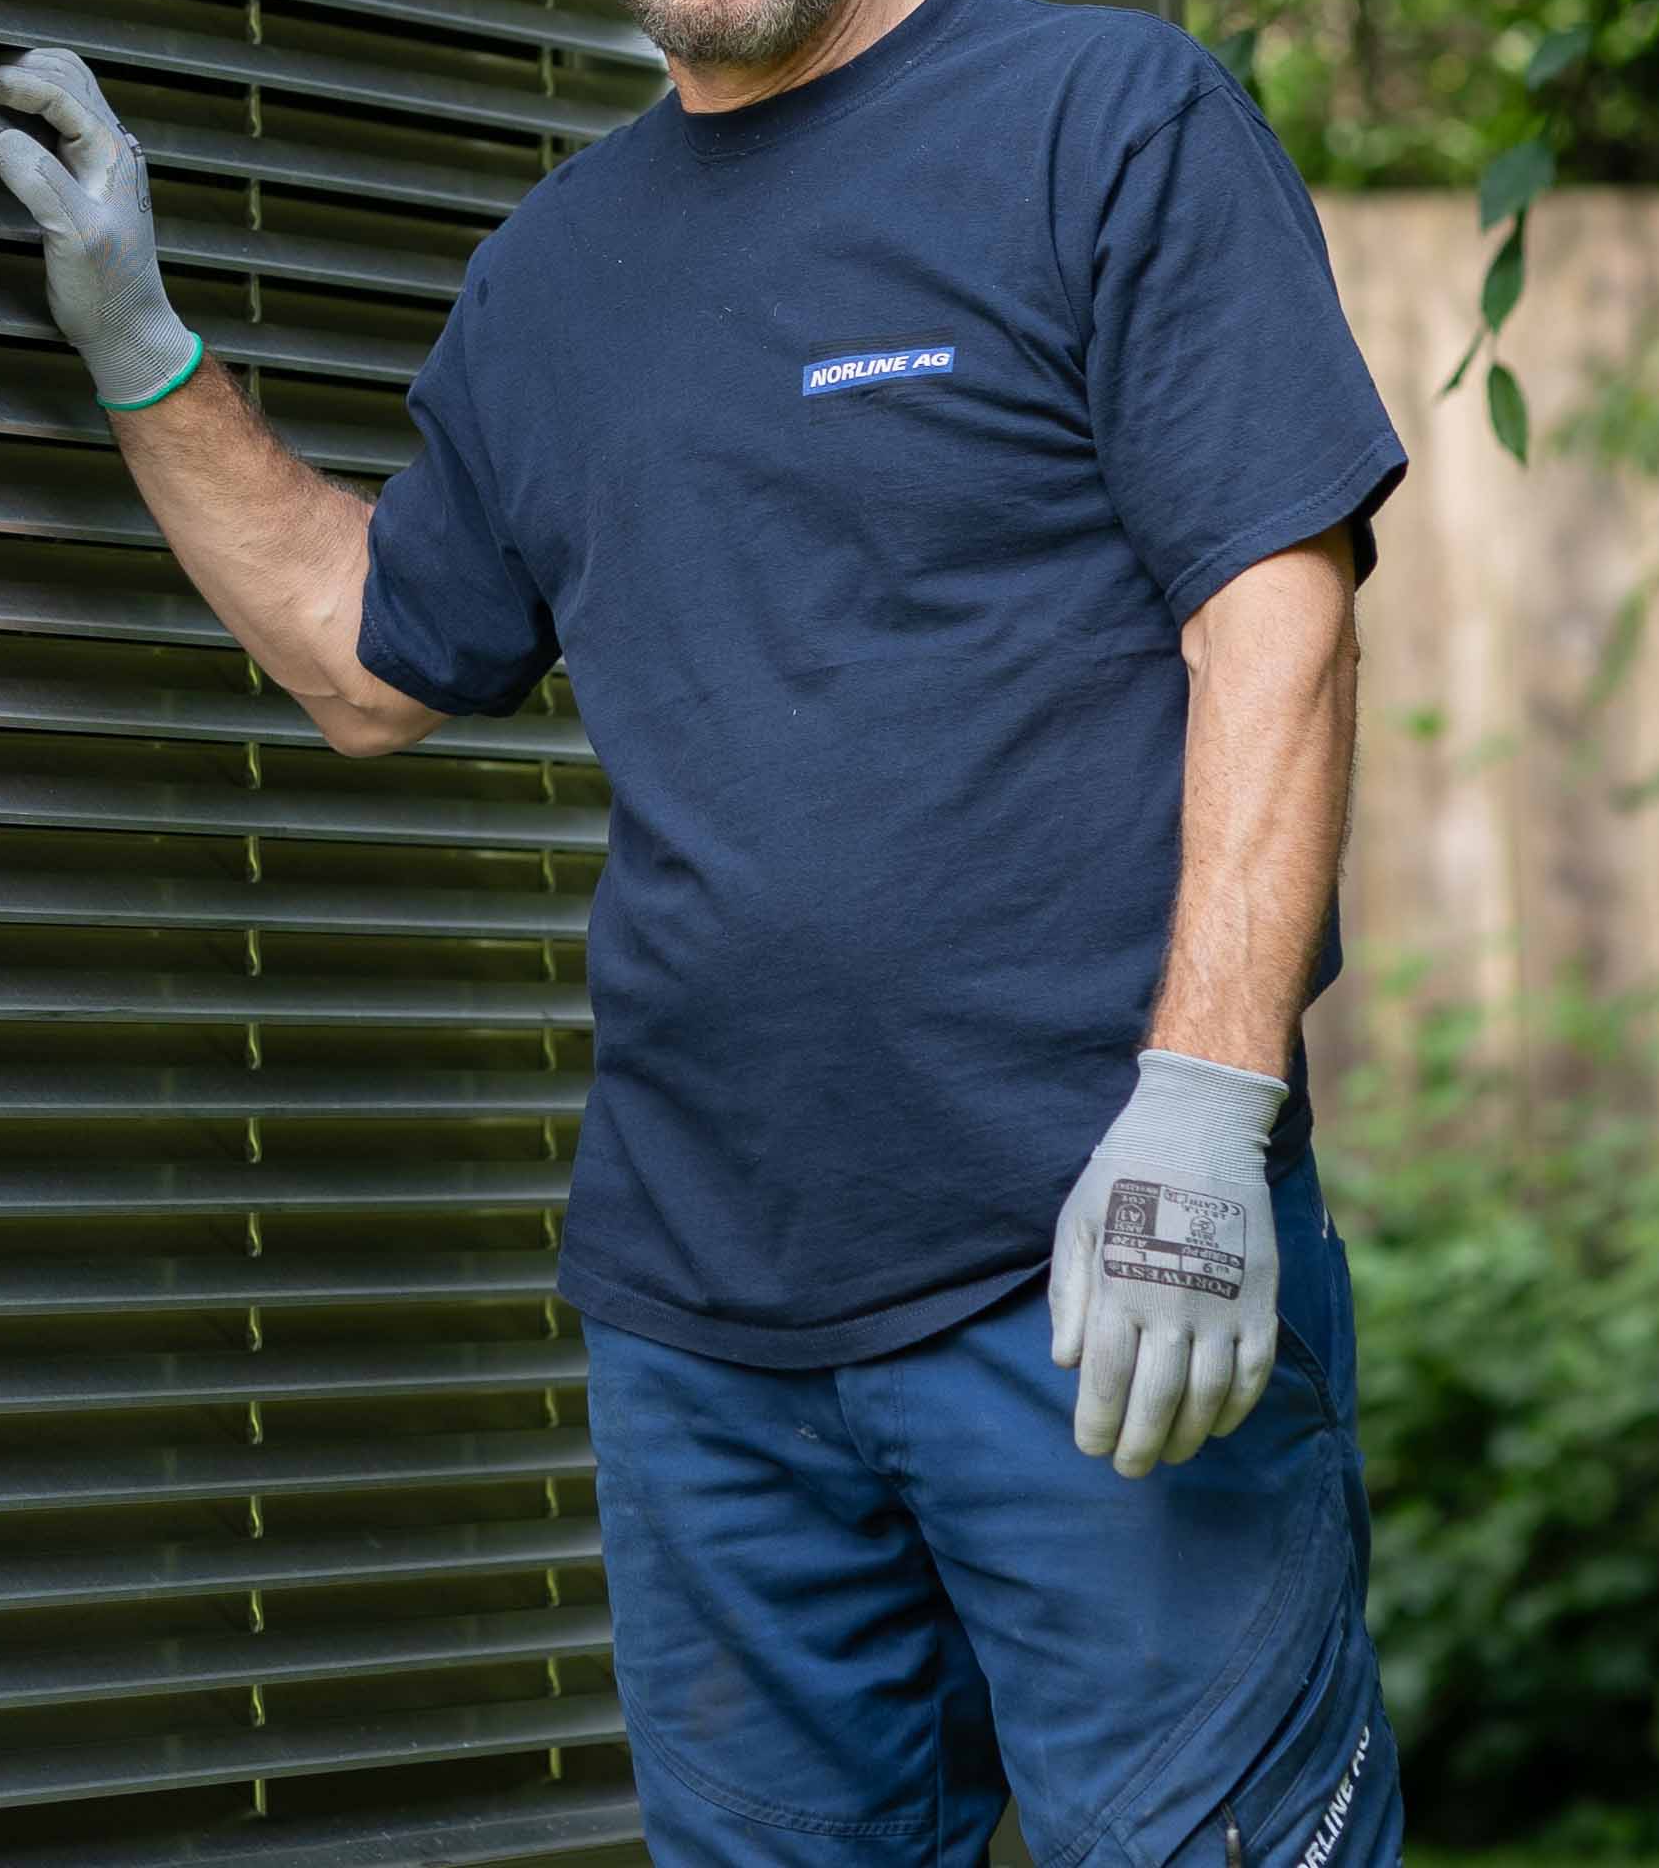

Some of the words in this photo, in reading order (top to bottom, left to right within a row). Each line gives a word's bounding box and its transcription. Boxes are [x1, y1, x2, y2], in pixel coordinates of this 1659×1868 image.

[810, 355, 910, 388] NORLINE
[912, 353, 951, 369] AG
[1121, 1210, 1141, 1222] A1
[1119, 1264, 1233, 1298] PORTWEST
